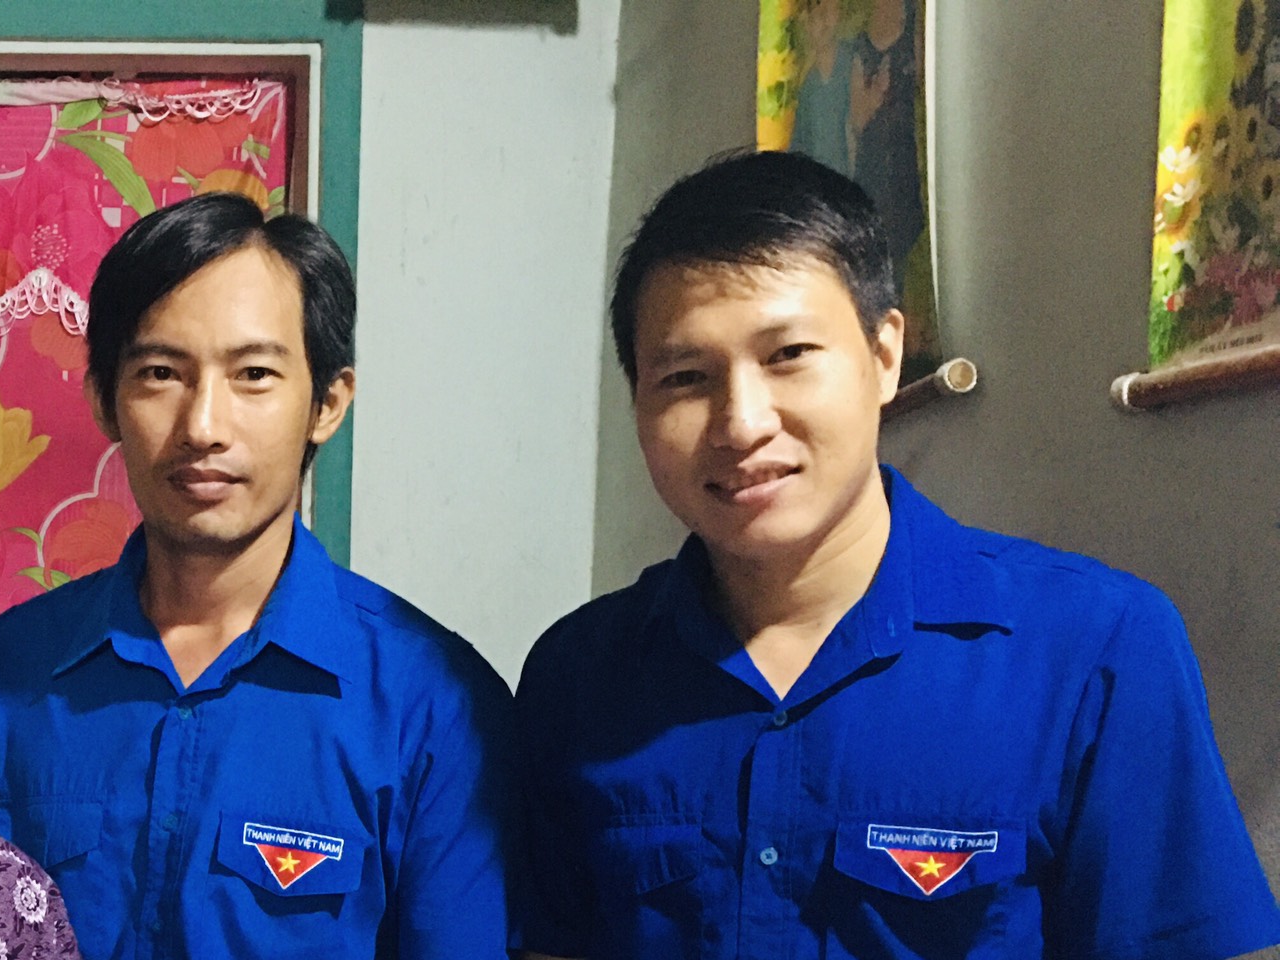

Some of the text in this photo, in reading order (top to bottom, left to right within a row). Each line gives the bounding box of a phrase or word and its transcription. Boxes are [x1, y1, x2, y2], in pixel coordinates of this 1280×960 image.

[246, 828, 276, 842] THANH
[319, 841, 340, 853] NAM
[871, 831, 911, 844] THANH
[966, 838, 995, 848] NAM
